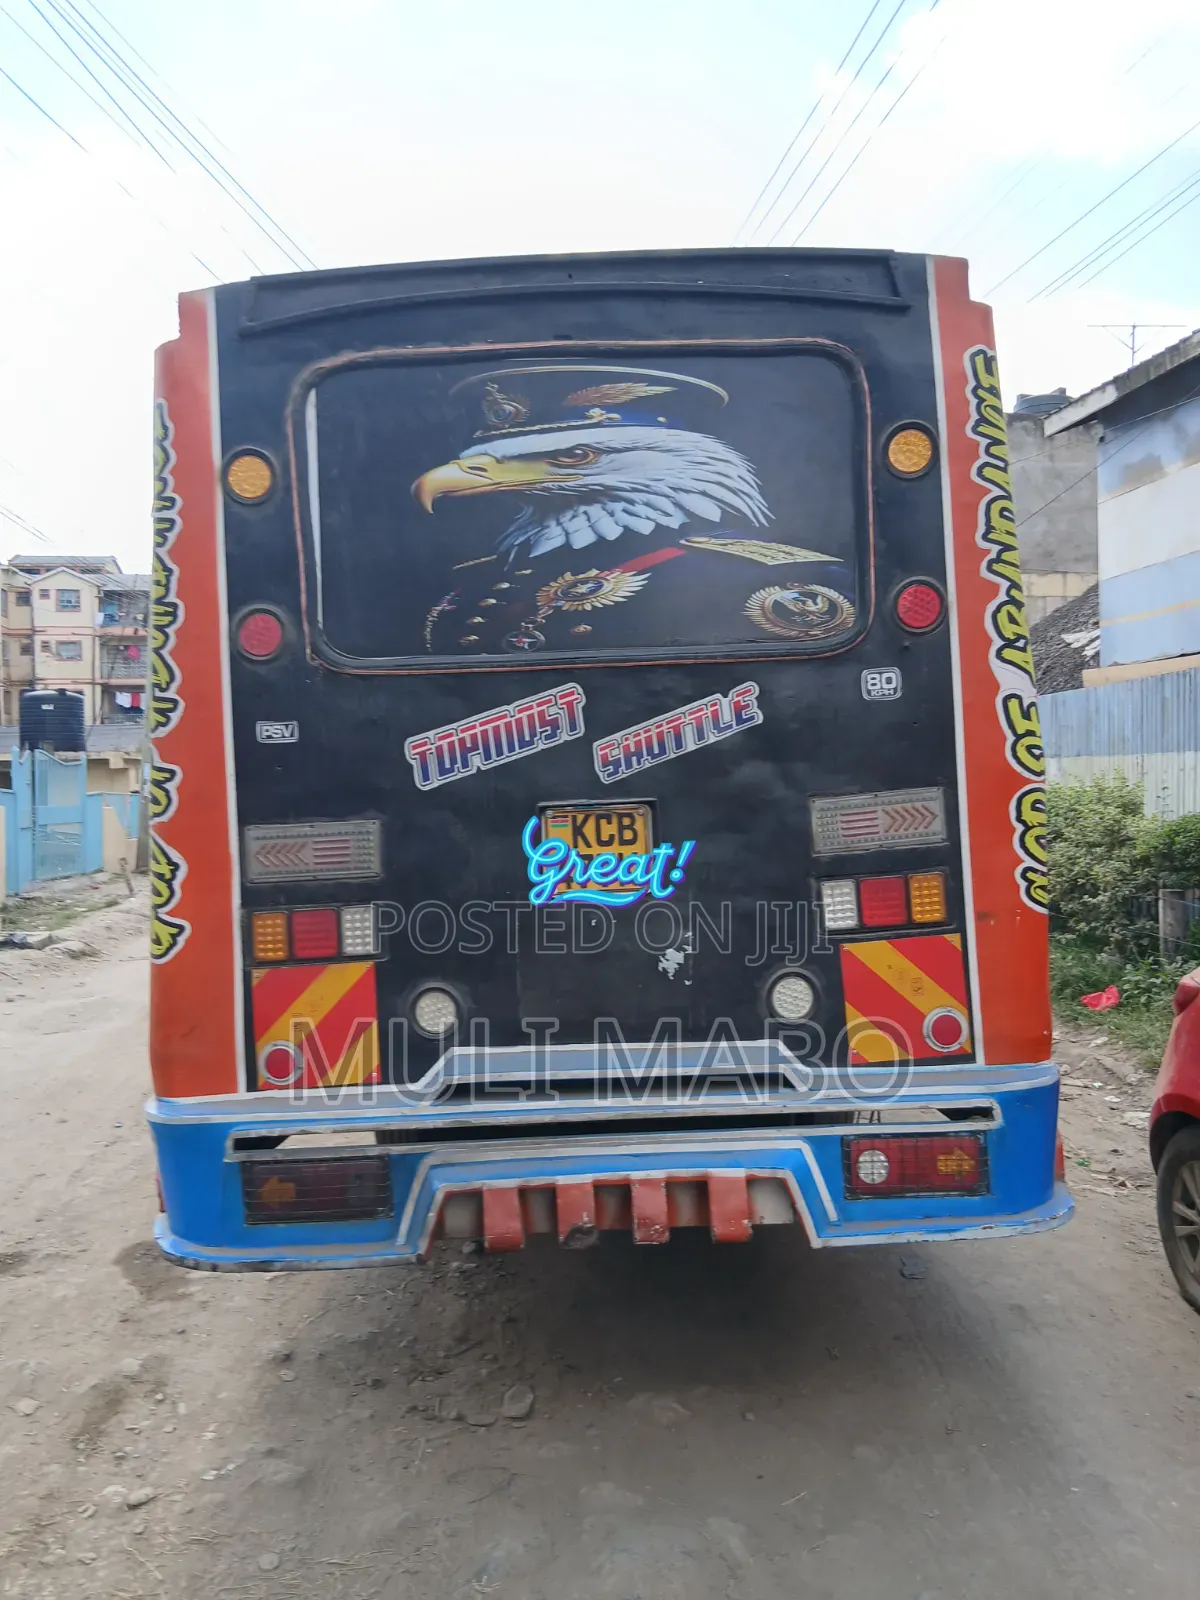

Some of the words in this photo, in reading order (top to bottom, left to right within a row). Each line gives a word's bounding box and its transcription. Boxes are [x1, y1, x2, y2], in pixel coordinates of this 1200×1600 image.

[866, 672, 897, 690] 80
[260, 724, 294, 739] PSV
[407, 685, 584, 788] TOPMOST
[597, 684, 761, 781] SHUTTLE
[571, 812, 639, 849] KCB
